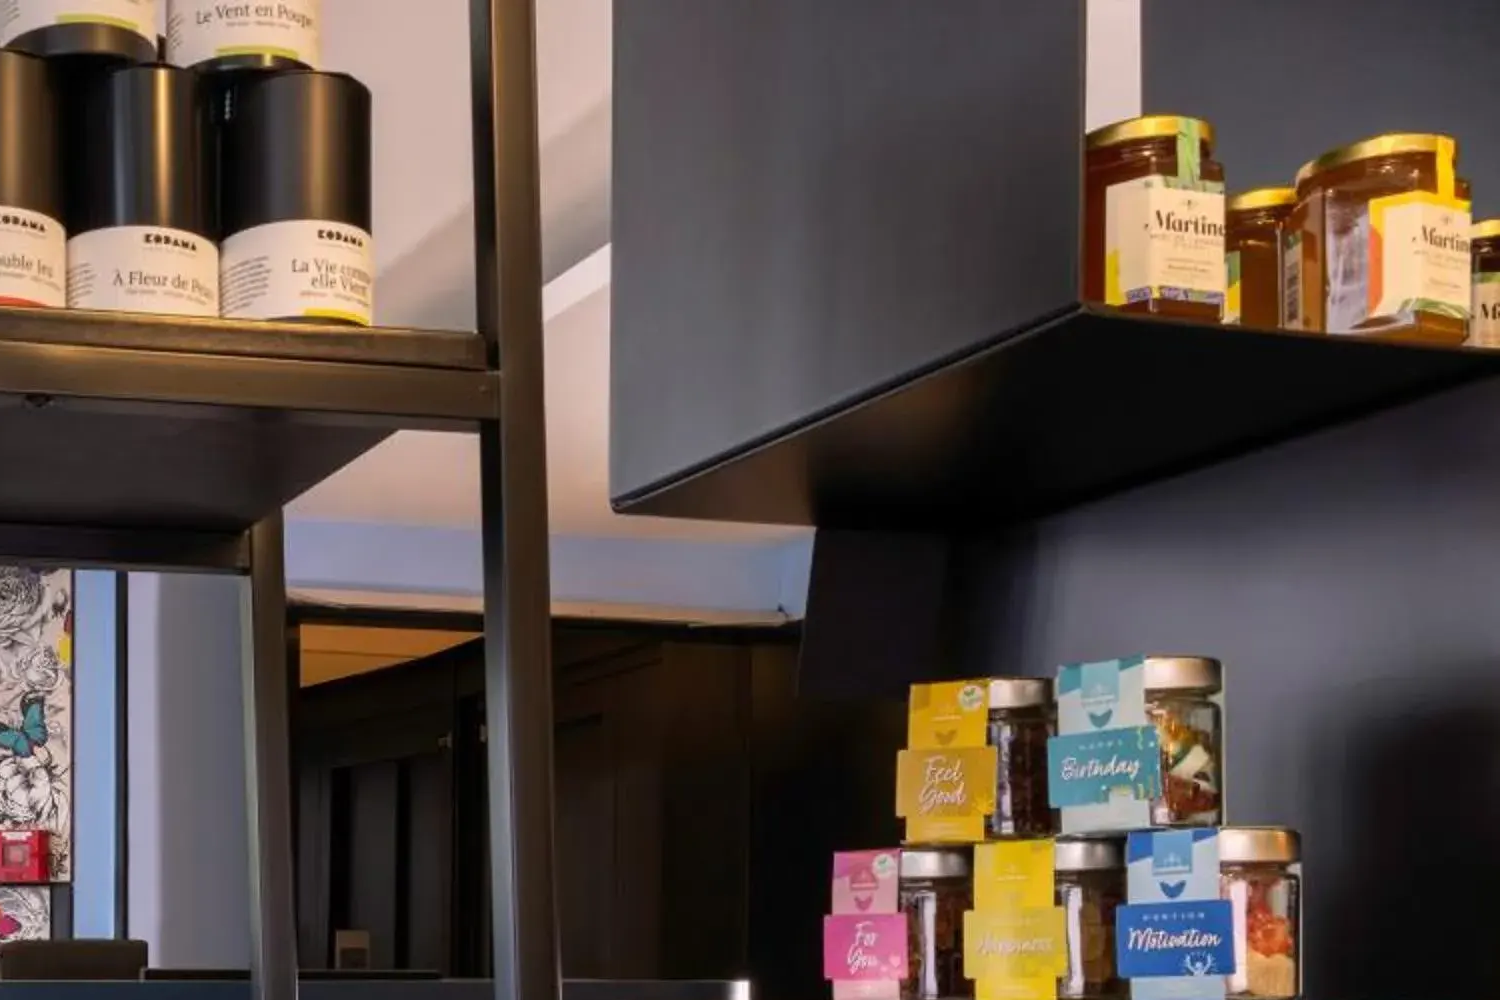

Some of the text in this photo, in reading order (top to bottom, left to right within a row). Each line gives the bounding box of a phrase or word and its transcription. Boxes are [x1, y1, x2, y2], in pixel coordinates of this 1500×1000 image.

[196, 10, 213, 25] Le
[215, 5, 250, 20] Vent
[255, 7, 273, 17] en
[143, 232, 198, 251] KODAMA
[317, 229, 364, 248] KODAMA
[291, 258, 309, 273] La
[313, 258, 337, 274] Vie
[129, 271, 168, 287] Fleur
[171, 273, 188, 290] de
[311, 273, 337, 289] elle
[924, 754, 963, 784] Feel
[1061, 754, 1140, 782] Birthday
[919, 780, 966, 815] Good
[855, 919, 878, 947] For
[1127, 927, 1223, 952] Motivation
